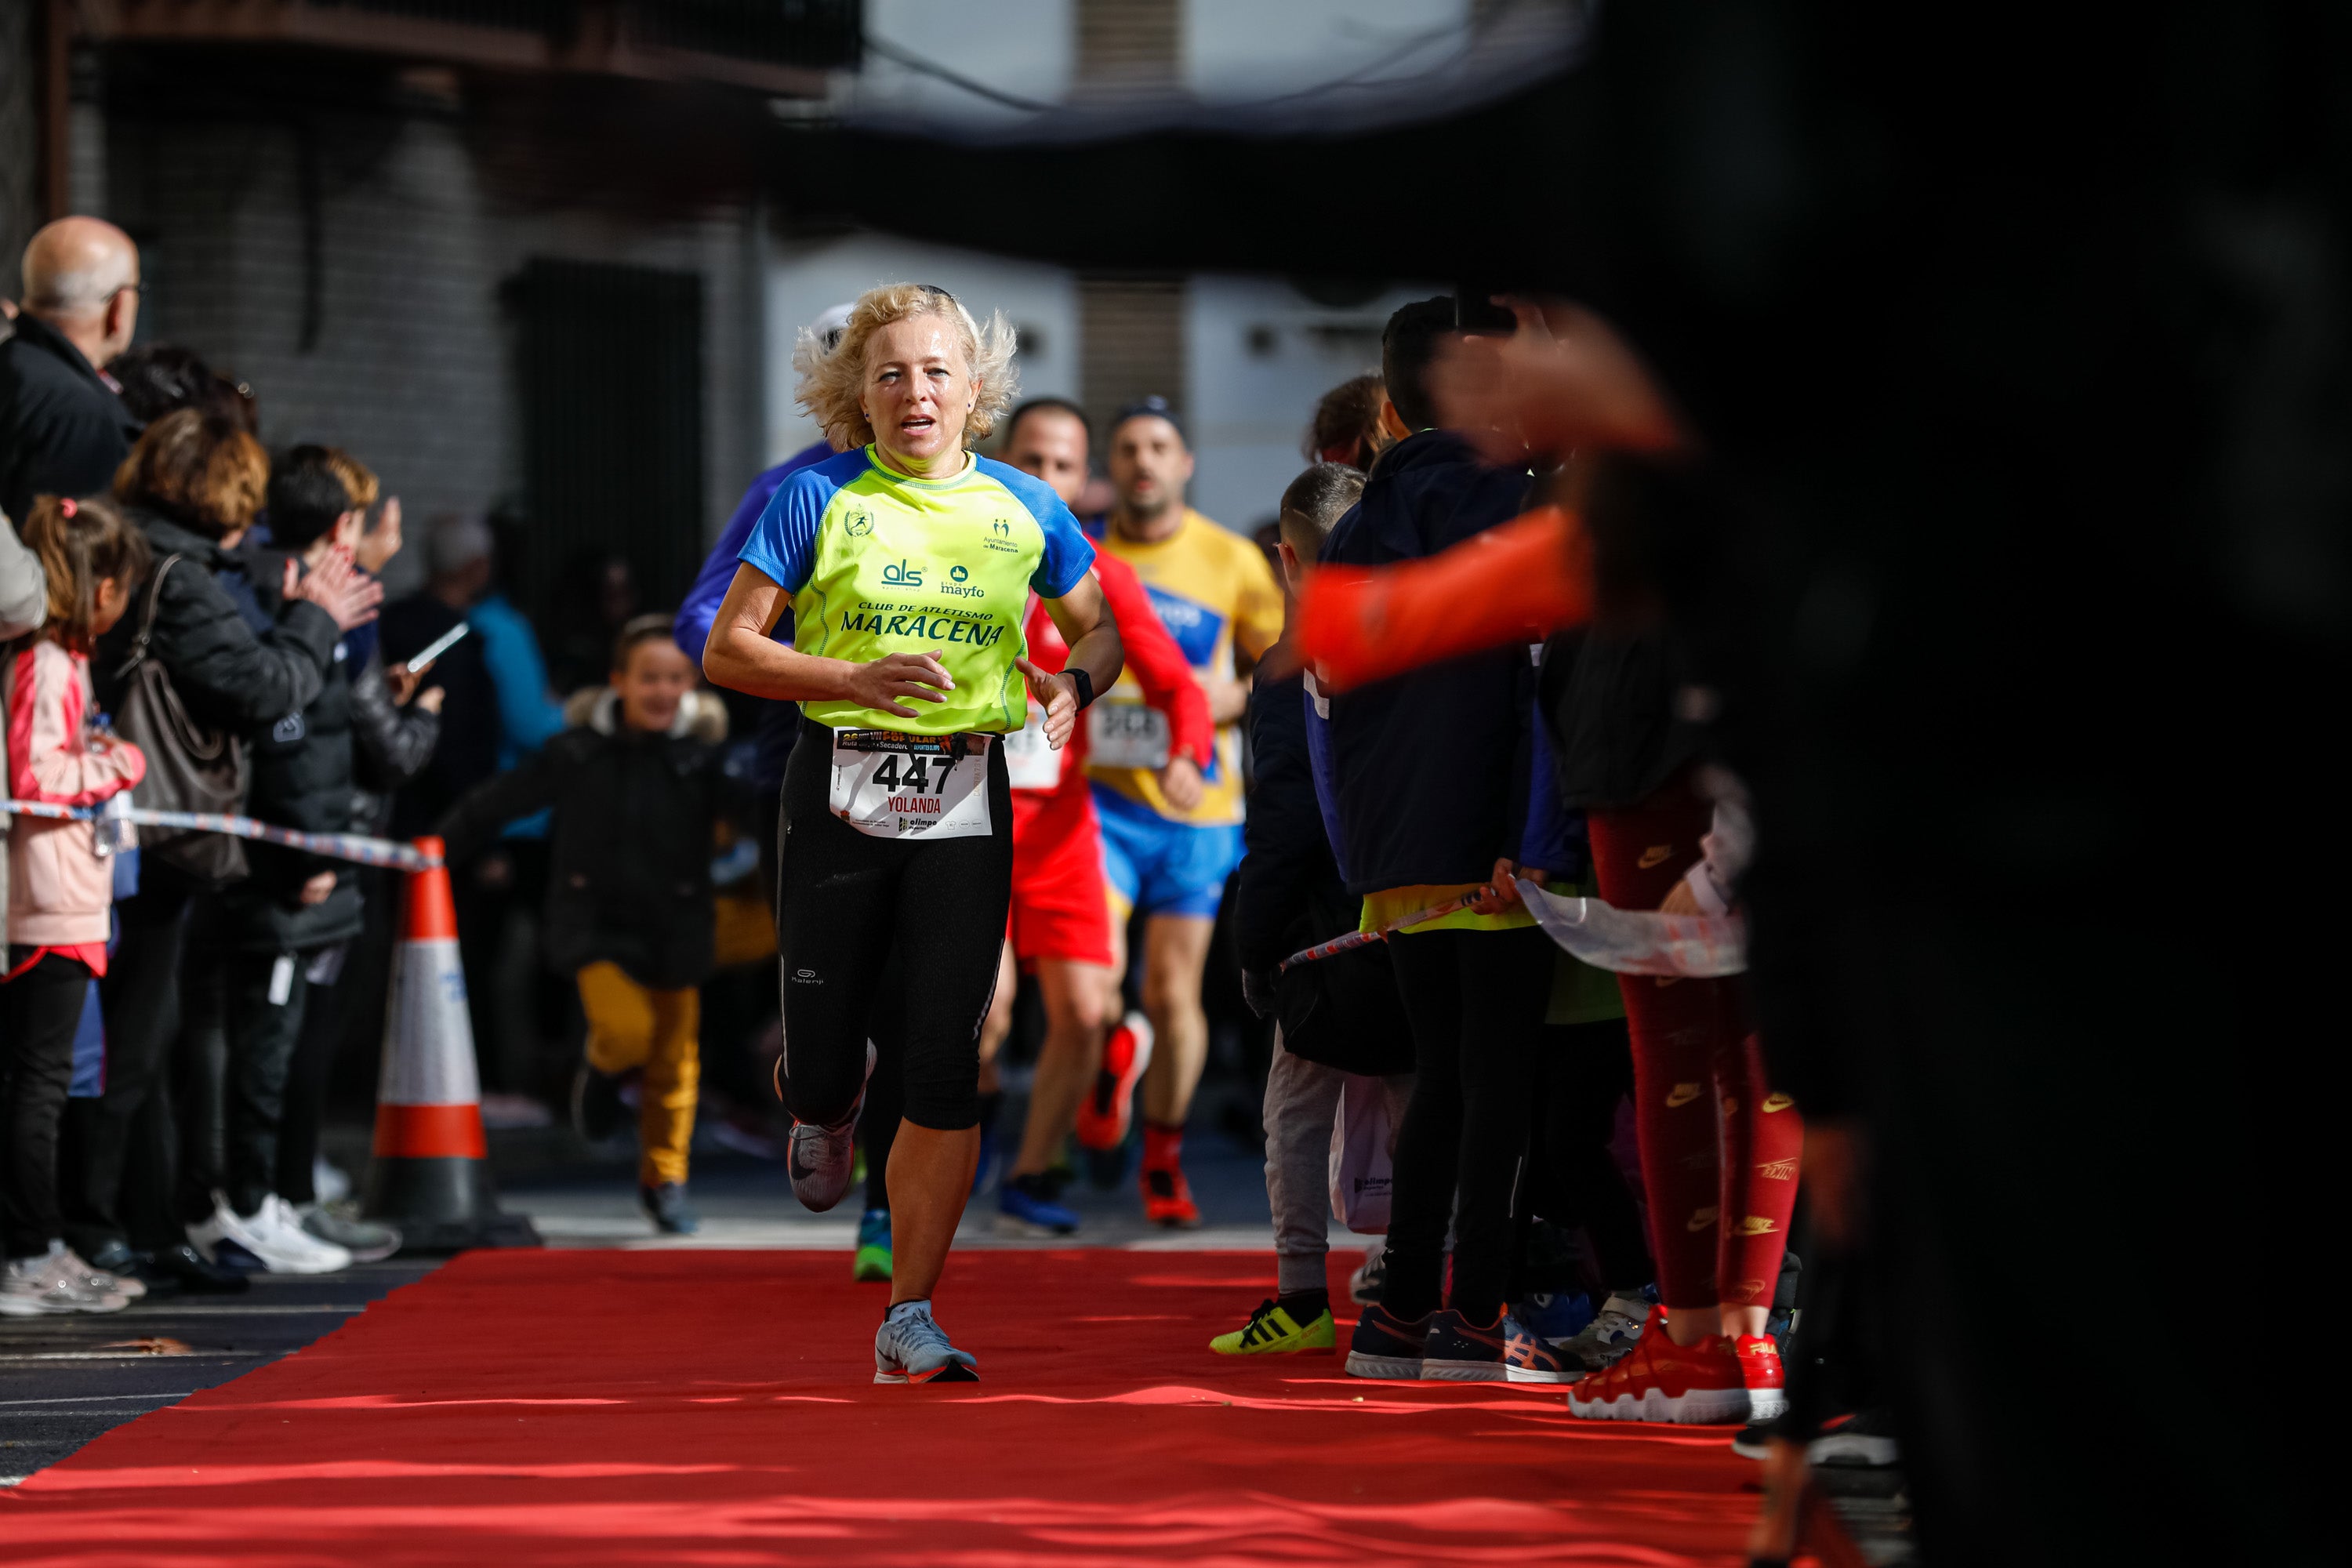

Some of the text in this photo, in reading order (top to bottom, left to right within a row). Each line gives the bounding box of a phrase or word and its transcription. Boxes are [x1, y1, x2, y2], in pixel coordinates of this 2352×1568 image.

[984, 536, 1018, 548] Ayuntamiento
[989, 543, 1018, 554] Maracena
[881, 559, 923, 586] als
[941, 585, 985, 598] mayfo
[858, 601, 894, 612] CLUB
[918, 606, 994, 621] ATLETISMO
[840, 611, 1004, 647] MARACENA
[873, 754, 956, 795] 447
[887, 796, 941, 814] YOLANDA
[909, 816, 938, 828] olimpo
[1749, 1342, 1778, 1356] FILA
